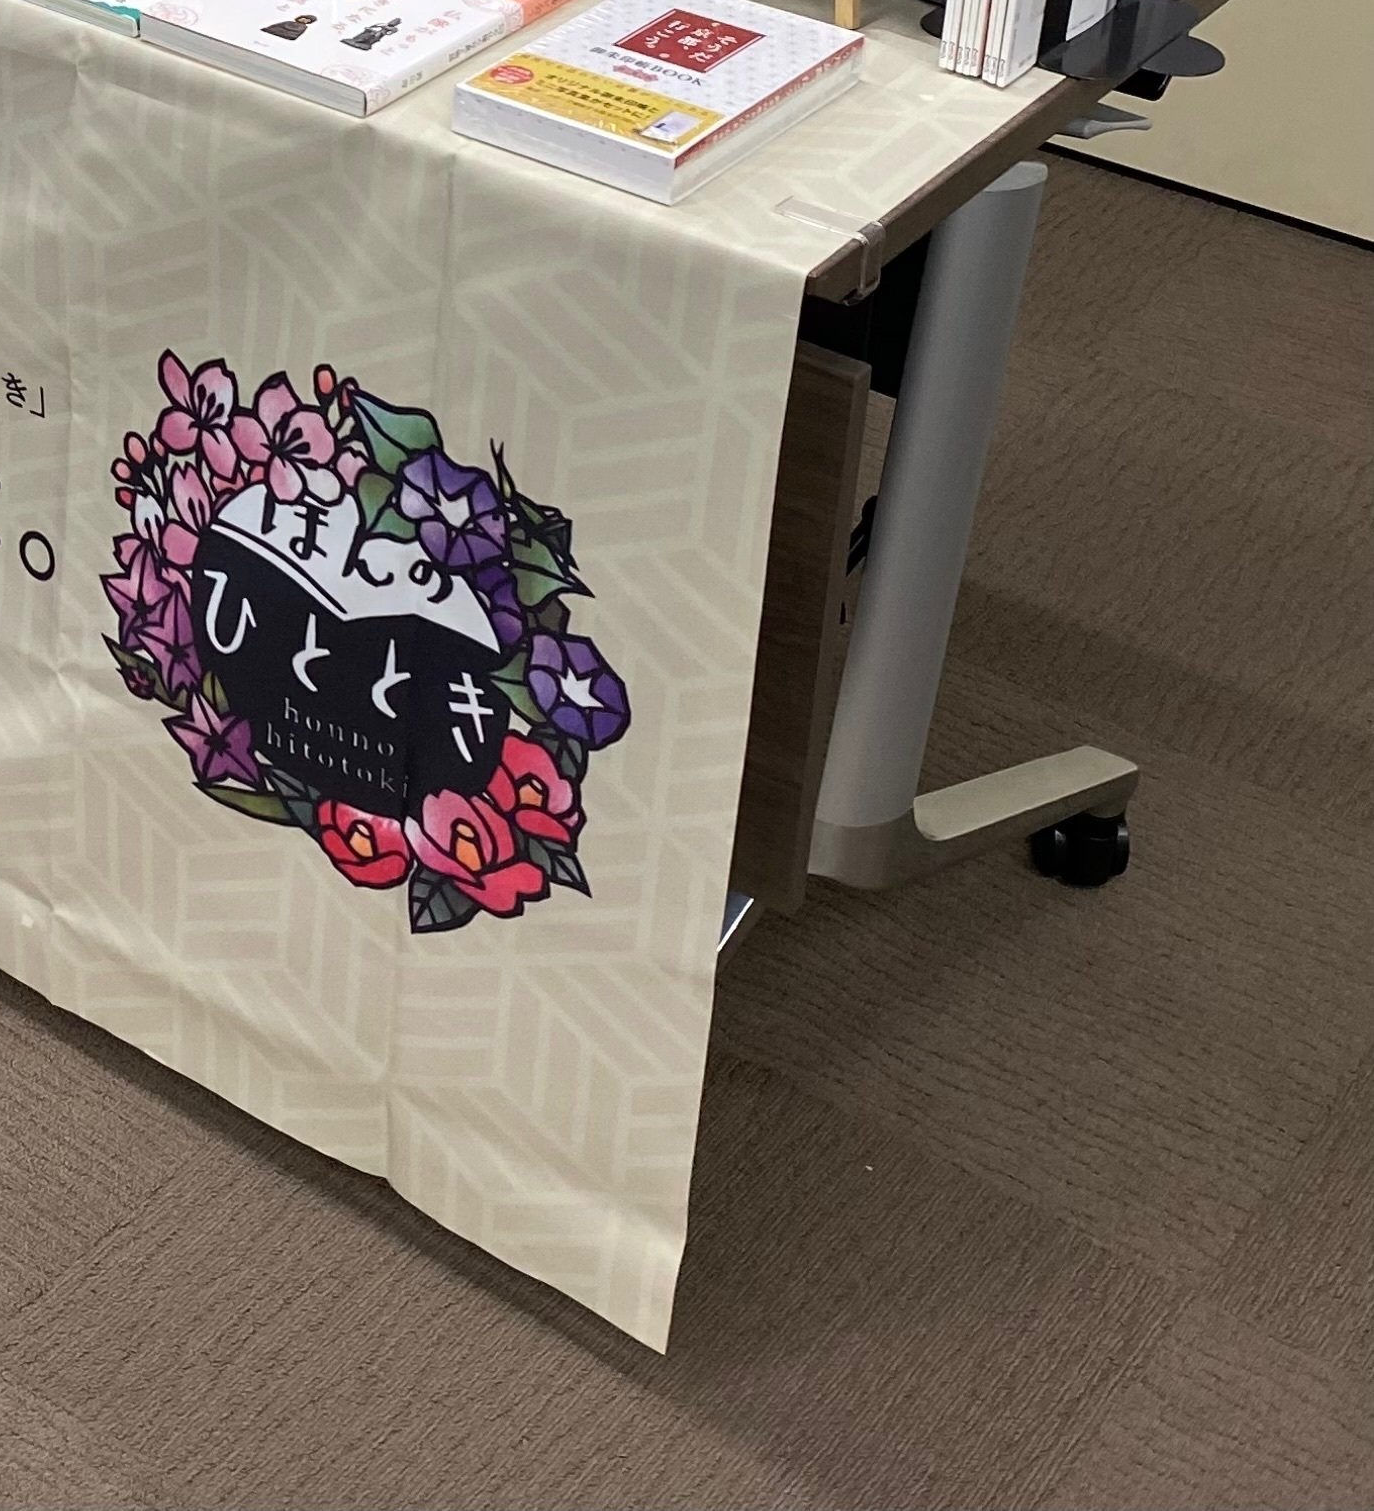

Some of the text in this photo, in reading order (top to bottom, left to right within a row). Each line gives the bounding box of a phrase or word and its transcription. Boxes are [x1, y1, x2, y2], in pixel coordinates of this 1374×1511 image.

[684, 34, 741, 63] そうだ
[260, 486, 456, 604] ほんの
[204, 569, 495, 763] ひととき
[266, 720, 410, 800] hitotoki
[284, 696, 397, 759] honno
